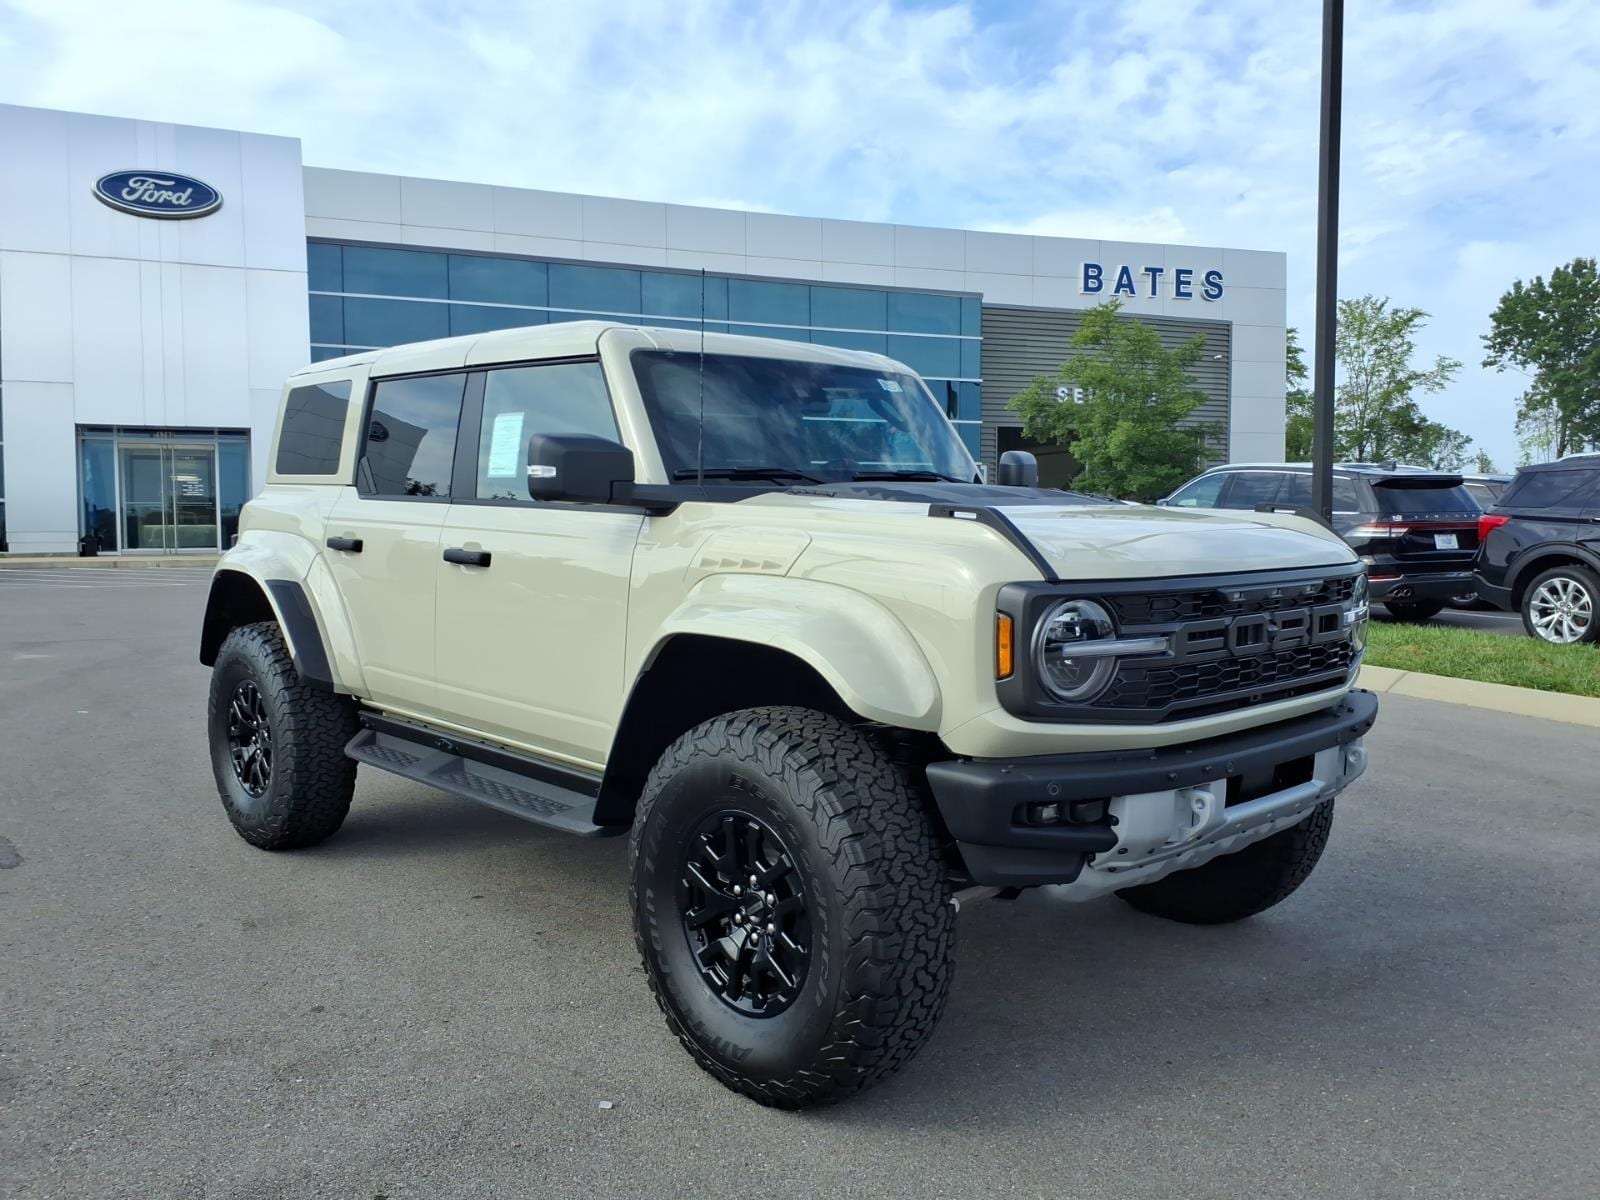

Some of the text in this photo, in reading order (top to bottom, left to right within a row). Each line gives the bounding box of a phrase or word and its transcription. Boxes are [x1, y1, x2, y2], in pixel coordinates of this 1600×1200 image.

[121, 176, 193, 206] Ford
[1081, 262, 1224, 301] BATES
[1175, 603, 1346, 660] FORD
